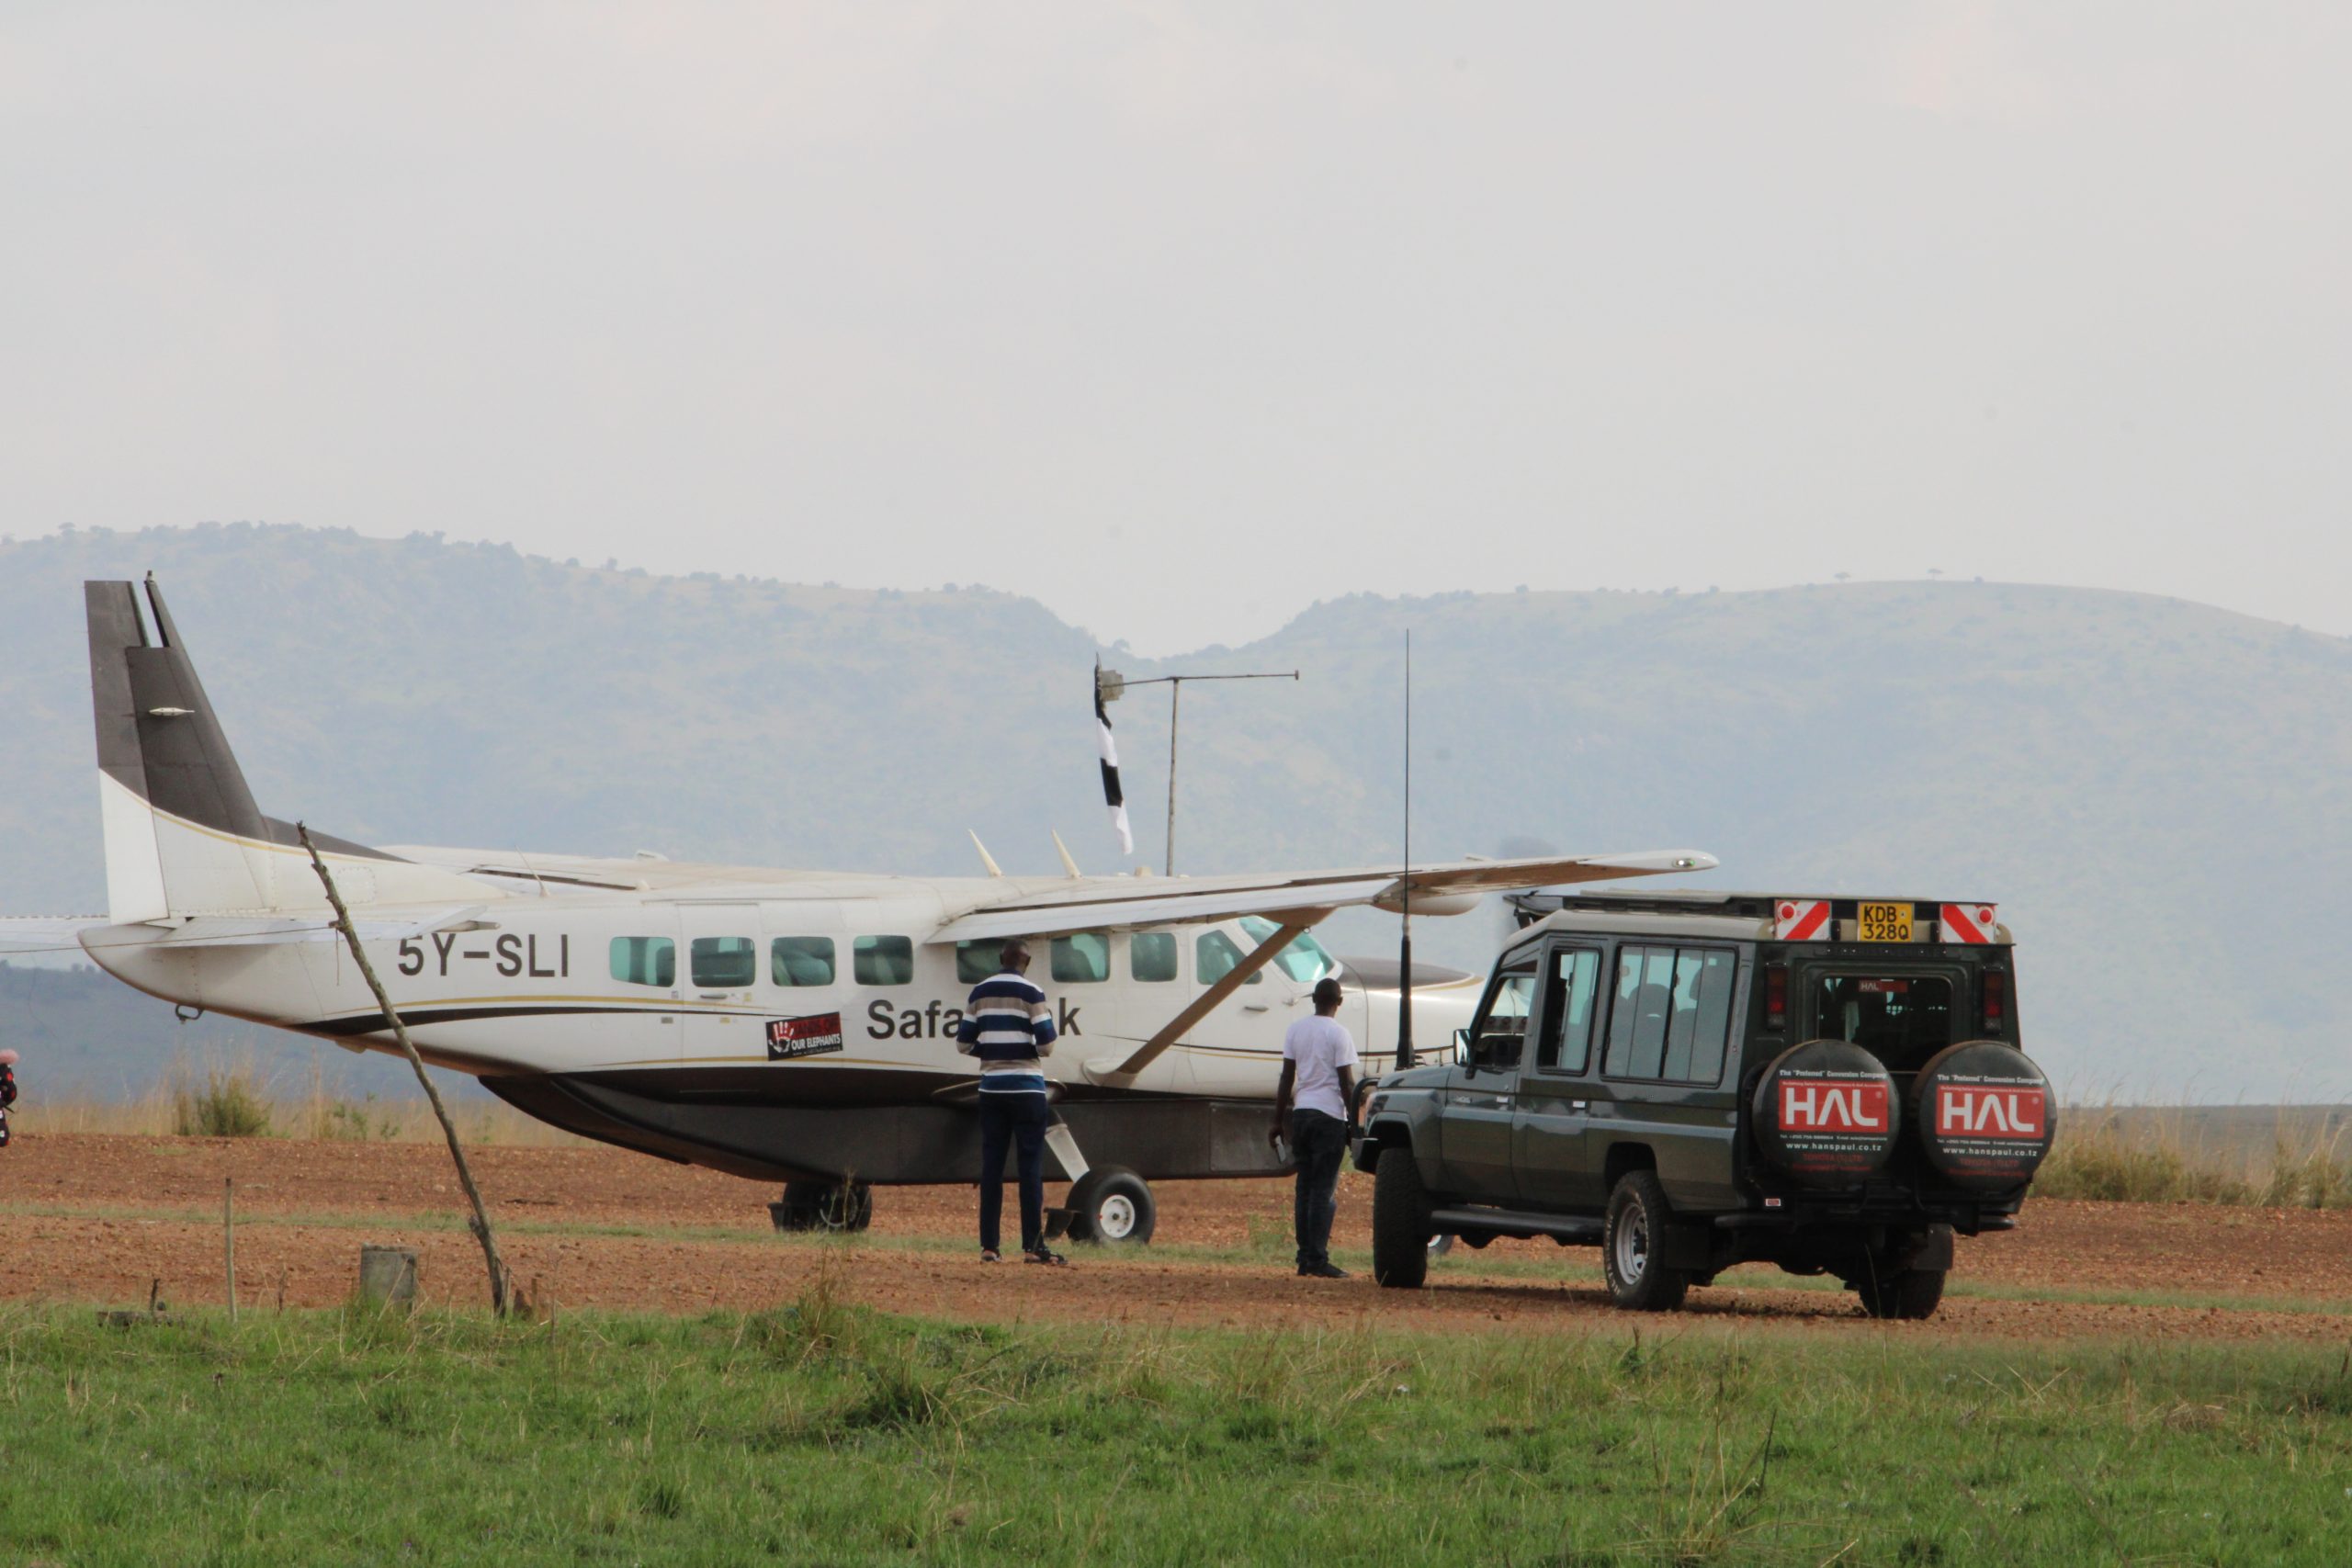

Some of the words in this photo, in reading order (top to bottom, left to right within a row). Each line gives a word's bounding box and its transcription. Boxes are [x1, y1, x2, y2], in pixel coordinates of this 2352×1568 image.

[1863, 905, 1897, 923] KDB
[1863, 923, 1909, 941] 328Q
[398, 933, 569, 977] 5Y-SLI
[1860, 982, 1880, 991] HAL
[791, 1038, 807, 1050] OUR
[808, 1033, 842, 1048] ELEPHANTS
[1785, 1088, 1879, 1127] HAL
[1943, 1092, 2035, 1133] HAL
[1785, 1142, 1883, 1152] www.hanspaul.co.tz
[1942, 1147, 2038, 1157] www.hanspaul.co.tz
